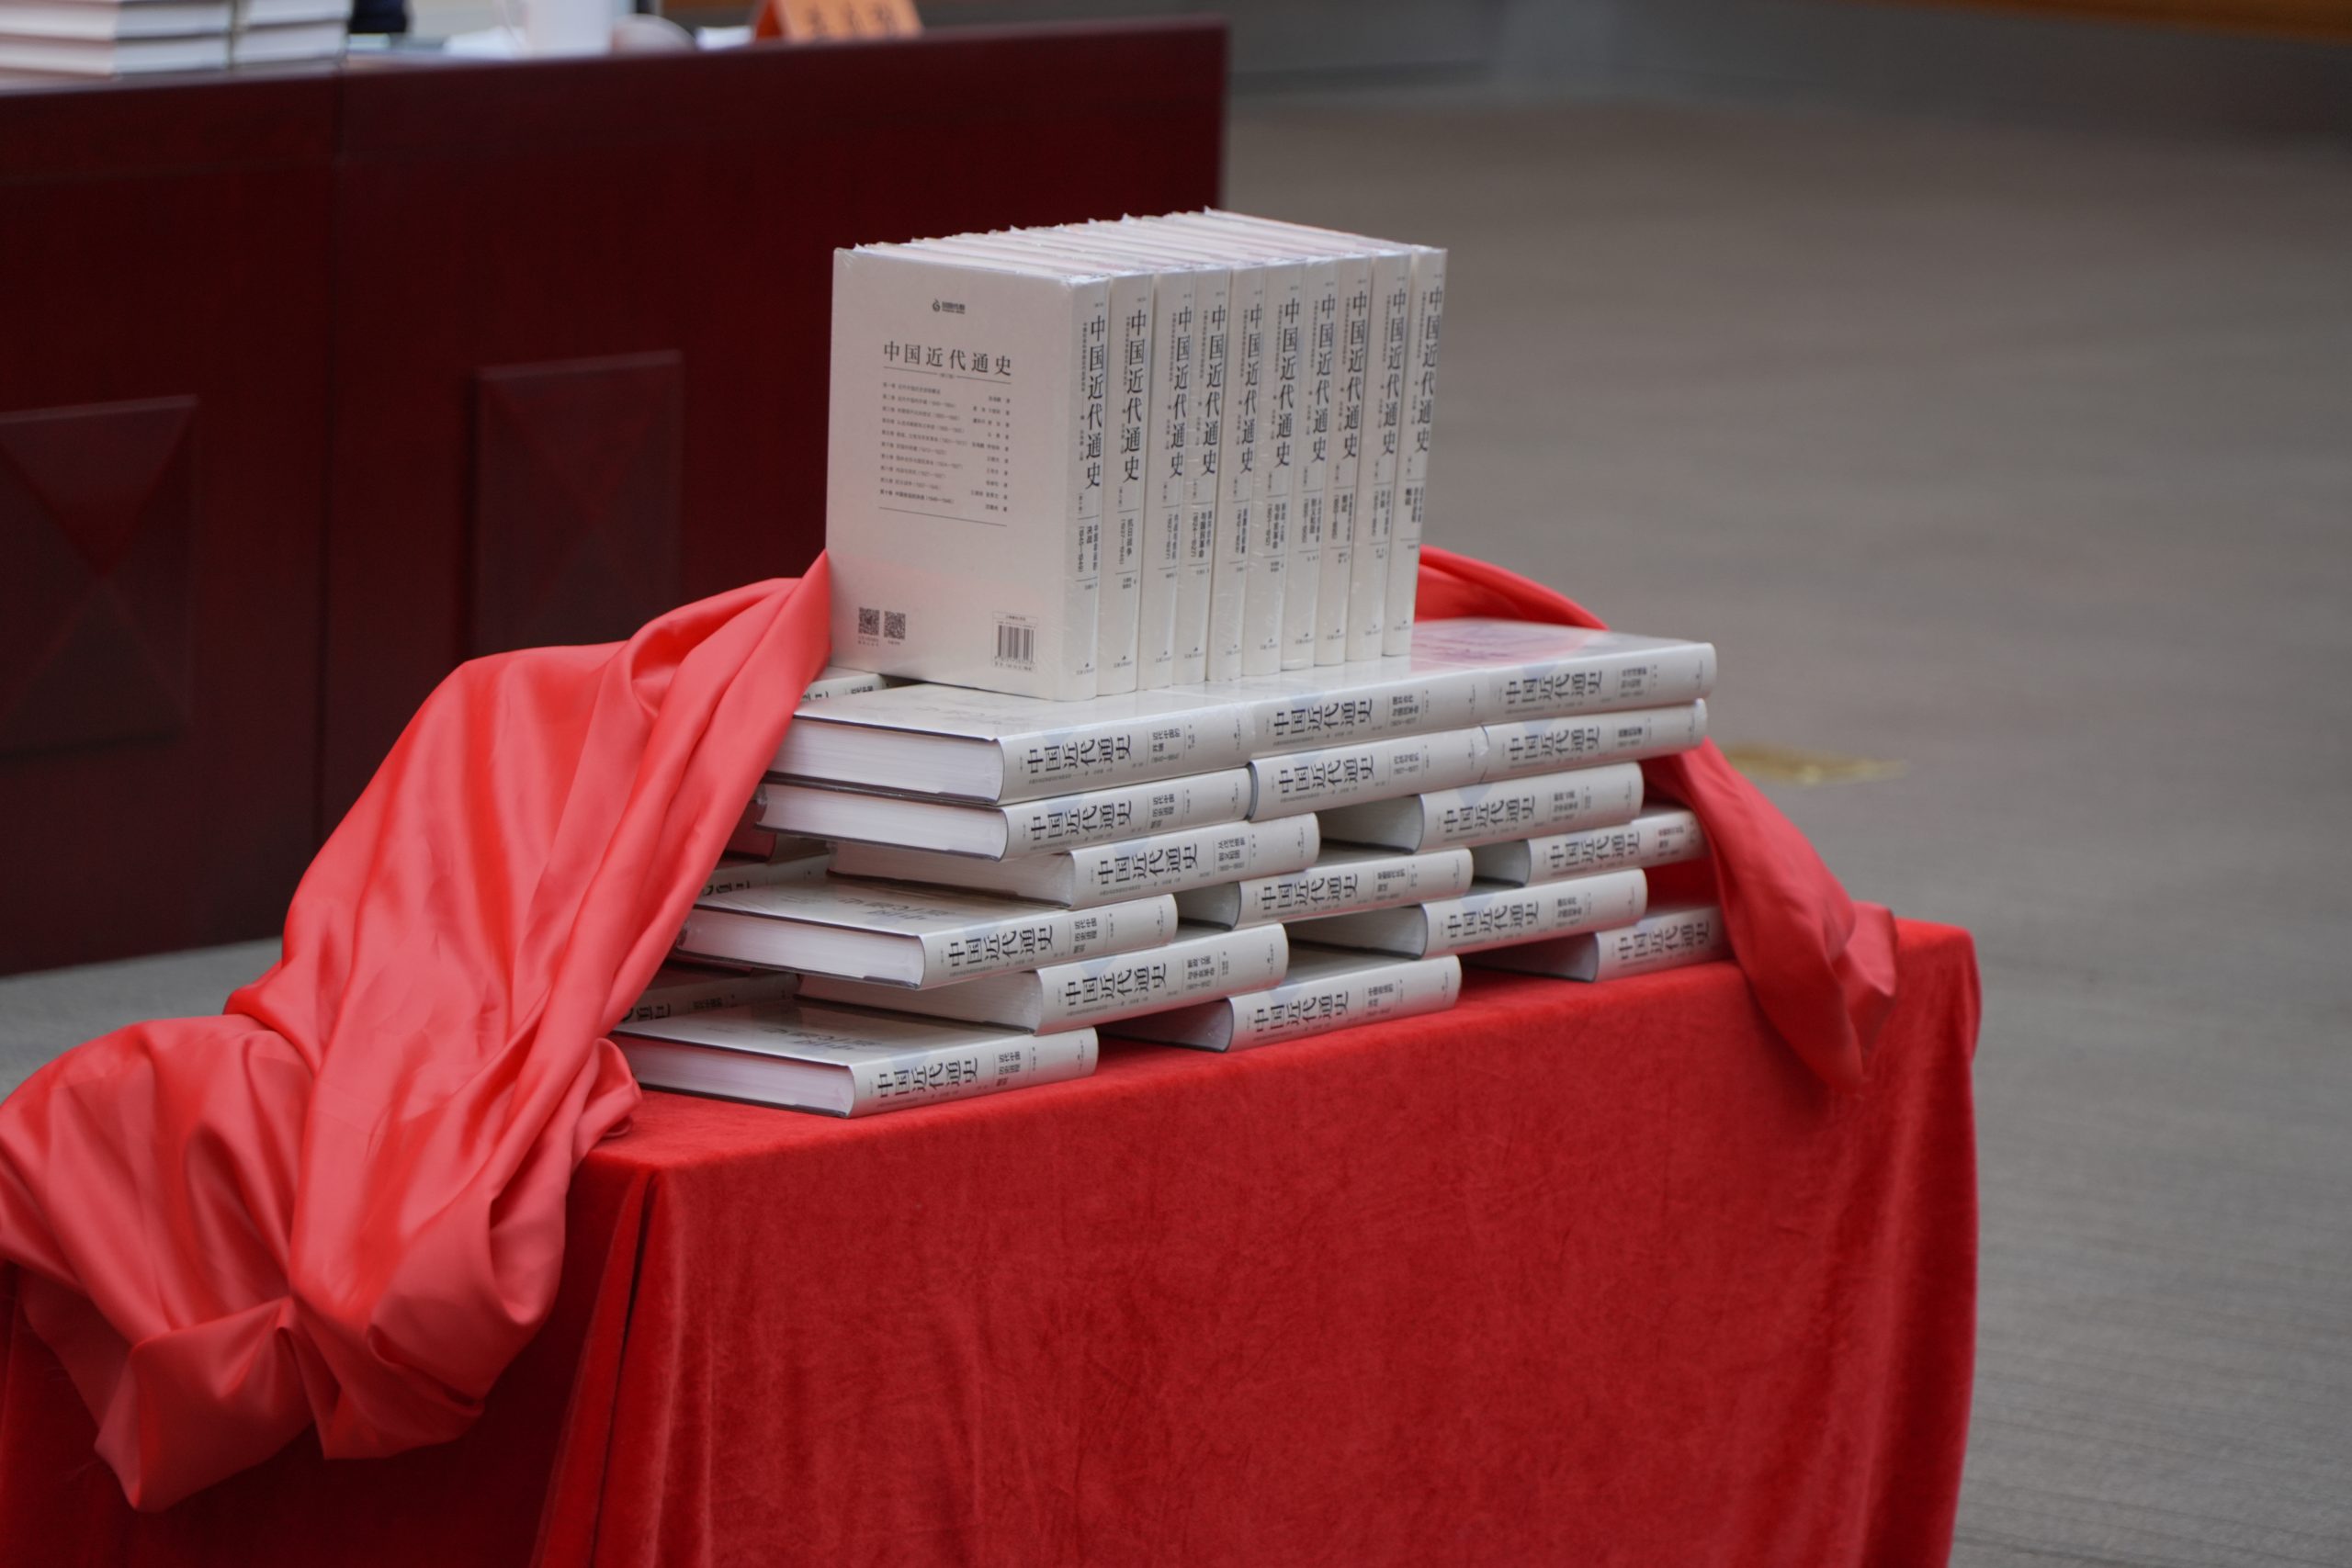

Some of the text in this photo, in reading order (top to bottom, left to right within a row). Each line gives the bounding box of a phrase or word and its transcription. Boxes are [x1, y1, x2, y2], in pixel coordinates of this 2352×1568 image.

[884, 341, 1012, 377] 中国近代通史
[1311, 293, 1336, 463] 中国近代通史
[1342, 290, 1368, 459] 中国近代通史
[1382, 288, 1407, 457] 中国近代通史
[1415, 286, 1443, 452] 中国近代通史
[1085, 314, 1105, 490] 中国近代通史
[1123, 309, 1147, 483] 中国近代通史
[1170, 305, 1193, 479] 中国近代通史
[1201, 304, 1227, 477] 中国近代通史
[1240, 303, 1262, 475] 中国近代通史
[1274, 298, 1300, 468] 中国近代通史
[1506, 670, 1603, 705] 中国近代通史
[1274, 698, 1374, 736] 中国近代通史
[1027, 734, 1132, 774] 中国近代通史
[1509, 726, 1600, 761] 中国近代通史
[1279, 754, 1374, 794] 中国近代通史
[1030, 800, 1133, 841] 中国近代通史
[1443, 795, 1535, 833] 中国近代通史
[1098, 843, 1198, 886] 中国近代通史
[1550, 831, 1641, 869] 中国近代通史
[1261, 874, 1359, 911] 中国近代通史
[1447, 900, 1540, 939] 中国近代通史
[949, 924, 1054, 968] 中国近代通史
[1617, 921, 1710, 961] 中国近代通史
[1066, 963, 1168, 1007] 中国近代通史
[1254, 990, 1350, 1032] 中国近代通史
[877, 1057, 978, 1099] 中国近代通史
